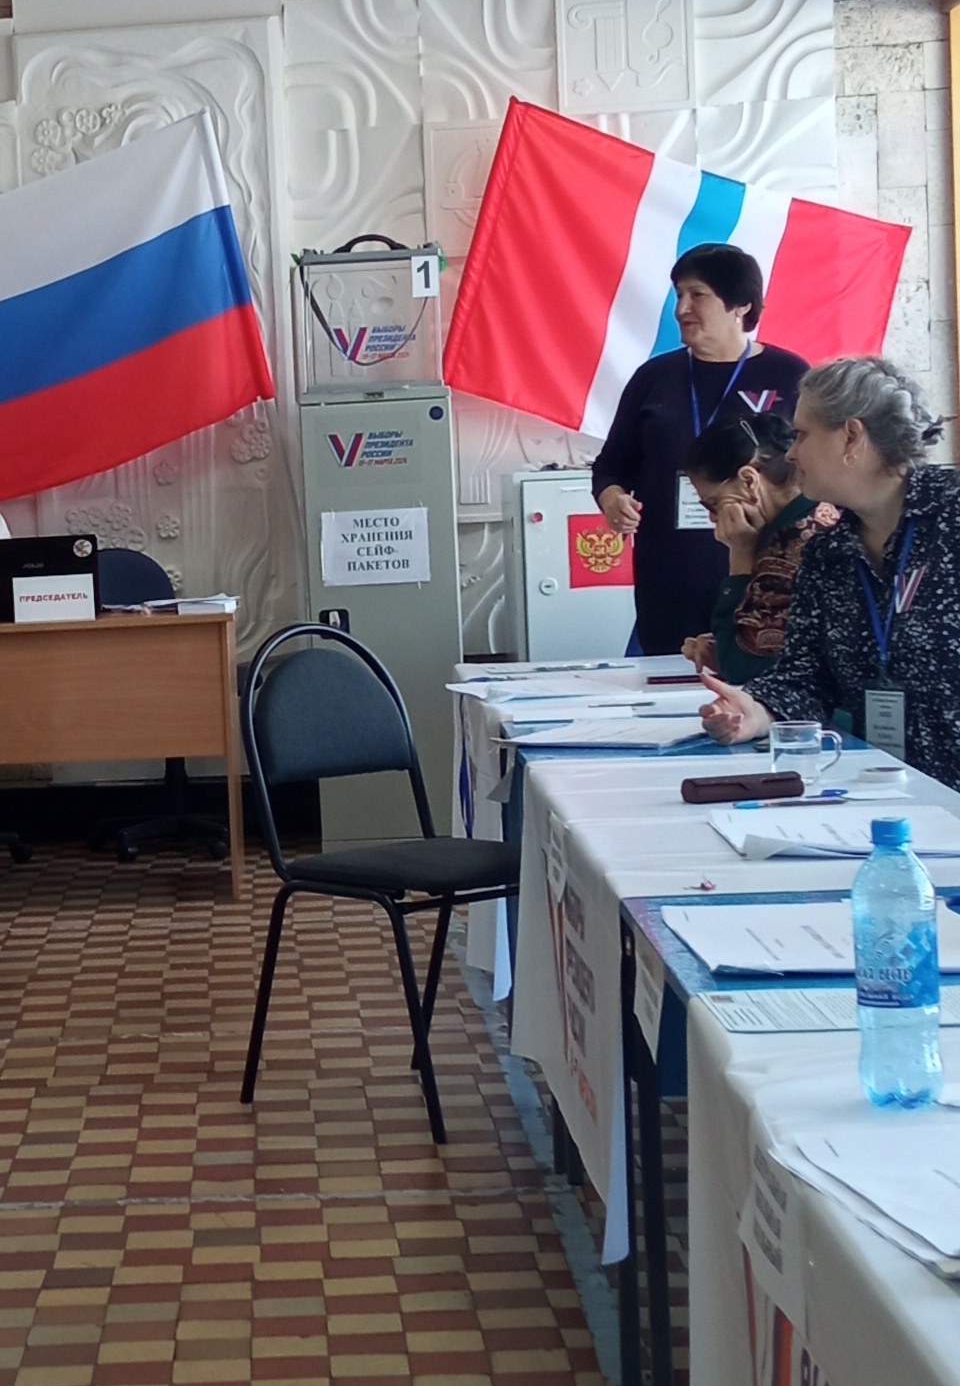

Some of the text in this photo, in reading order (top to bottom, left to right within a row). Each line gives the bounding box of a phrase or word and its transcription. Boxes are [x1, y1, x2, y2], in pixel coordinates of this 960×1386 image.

[416, 260, 431, 289] 1
[367, 431, 403, 440] ВЫБОРЫ
[364, 439, 414, 449] ПРЕЗИДЕНТА
[360, 450, 393, 458] РОССИИ
[353, 517, 400, 528] МЕСТО
[341, 530, 413, 543] ХРАНЕНИЯ
[356, 544, 398, 557] СЕЙФ-
[347, 559, 410, 572] ПАКЕТОВ
[19, 593, 88, 603] ПРЕДСЕДАТЕЛЬ
